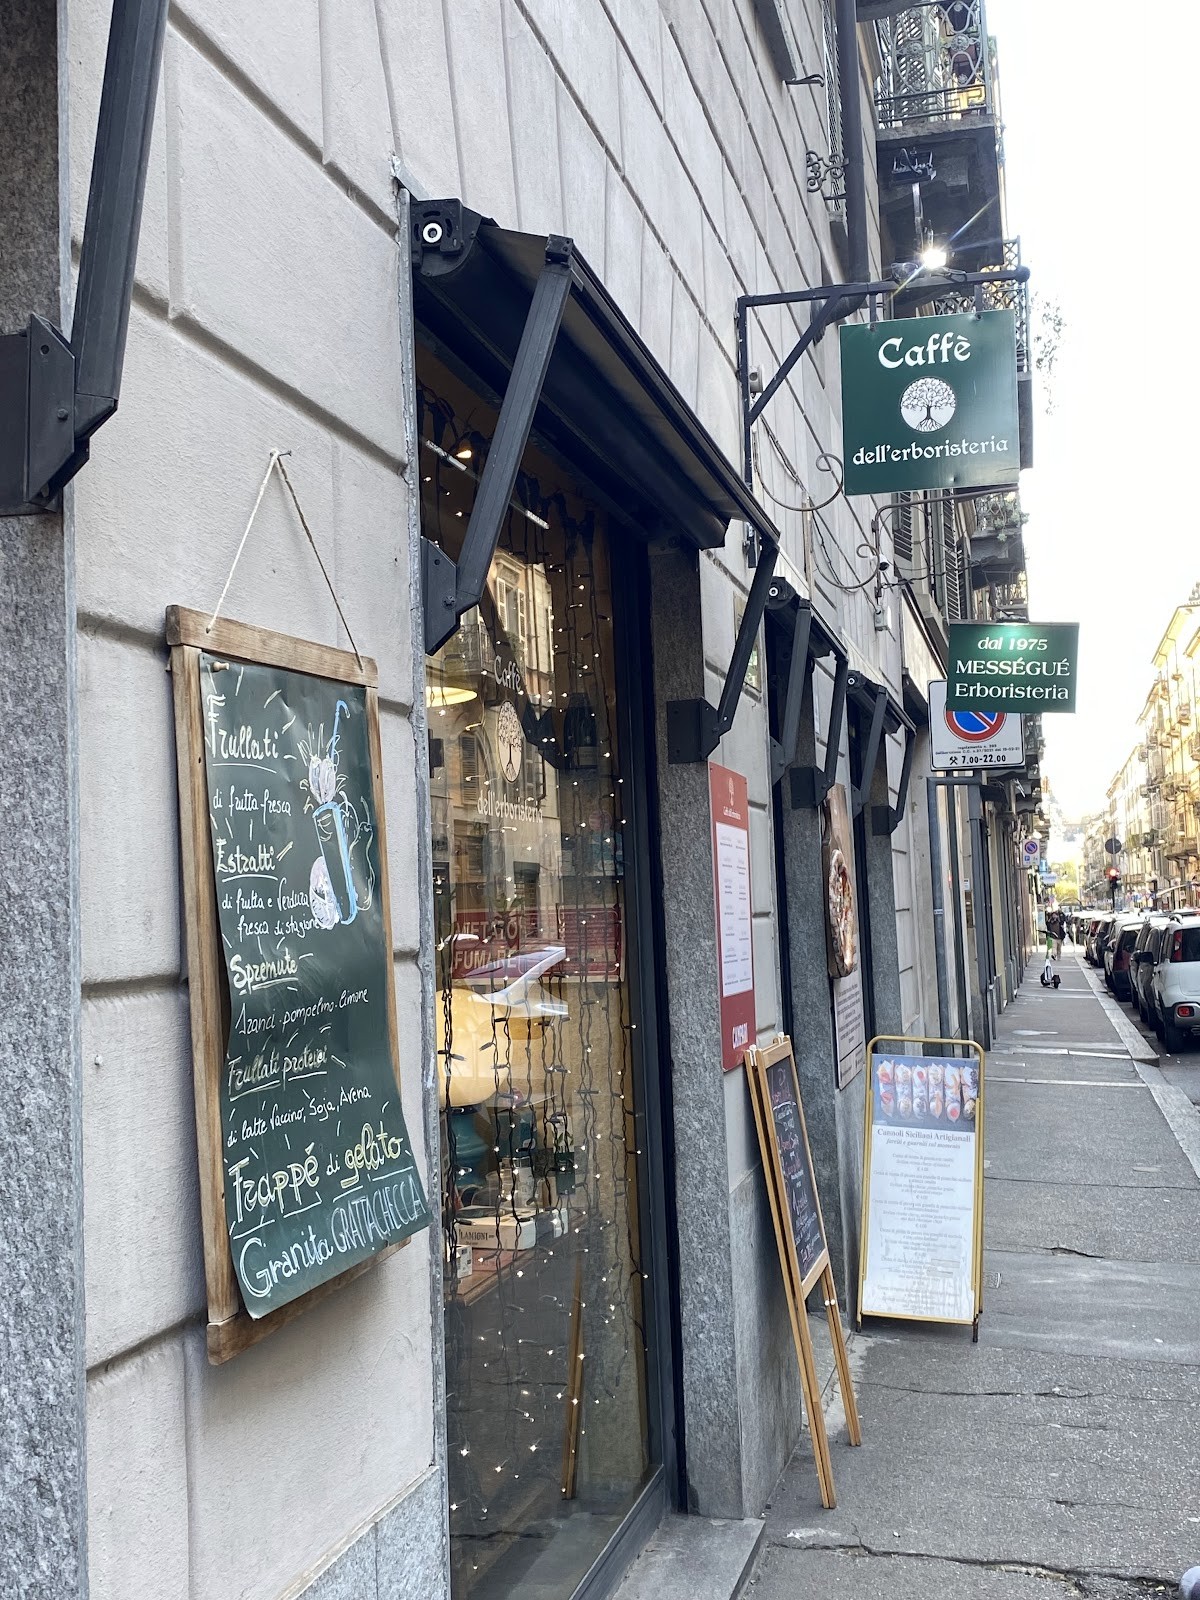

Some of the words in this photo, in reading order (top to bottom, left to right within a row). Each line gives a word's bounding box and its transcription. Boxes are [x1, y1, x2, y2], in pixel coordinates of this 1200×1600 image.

[878, 332, 971, 369] Caffè
[852, 435, 1008, 465] dell'erboristeria
[978, 637, 1003, 650] dal
[1008, 638, 1048, 651] 1975
[494, 655, 521, 692] Caffè
[955, 657, 1070, 676] MESSÉGUÉ
[954, 682, 1069, 700] Erboristeria
[207, 694, 279, 760] Frullati
[213, 788, 223, 809] di
[229, 785, 259, 816] frutta
[260, 789, 292, 825] fresca
[477, 790, 544, 824] dell'erboristeria
[216, 838, 276, 873] Estratti
[222, 893, 233, 909] di
[236, 888, 265, 914] frutta
[237, 915, 270, 942] fresca
[230, 948, 298, 994] Spremute
[228, 1050, 280, 1095] Frullati
[227, 1131, 238, 1148] di
[241, 1118, 268, 1140] latte
[229, 1142, 320, 1222] Frappé
[326, 1155, 340, 1176] di
[340, 1122, 403, 1188] gelato
[239, 1225, 333, 1297] Granita
[331, 1174, 426, 1253] GRATTACHECCA
